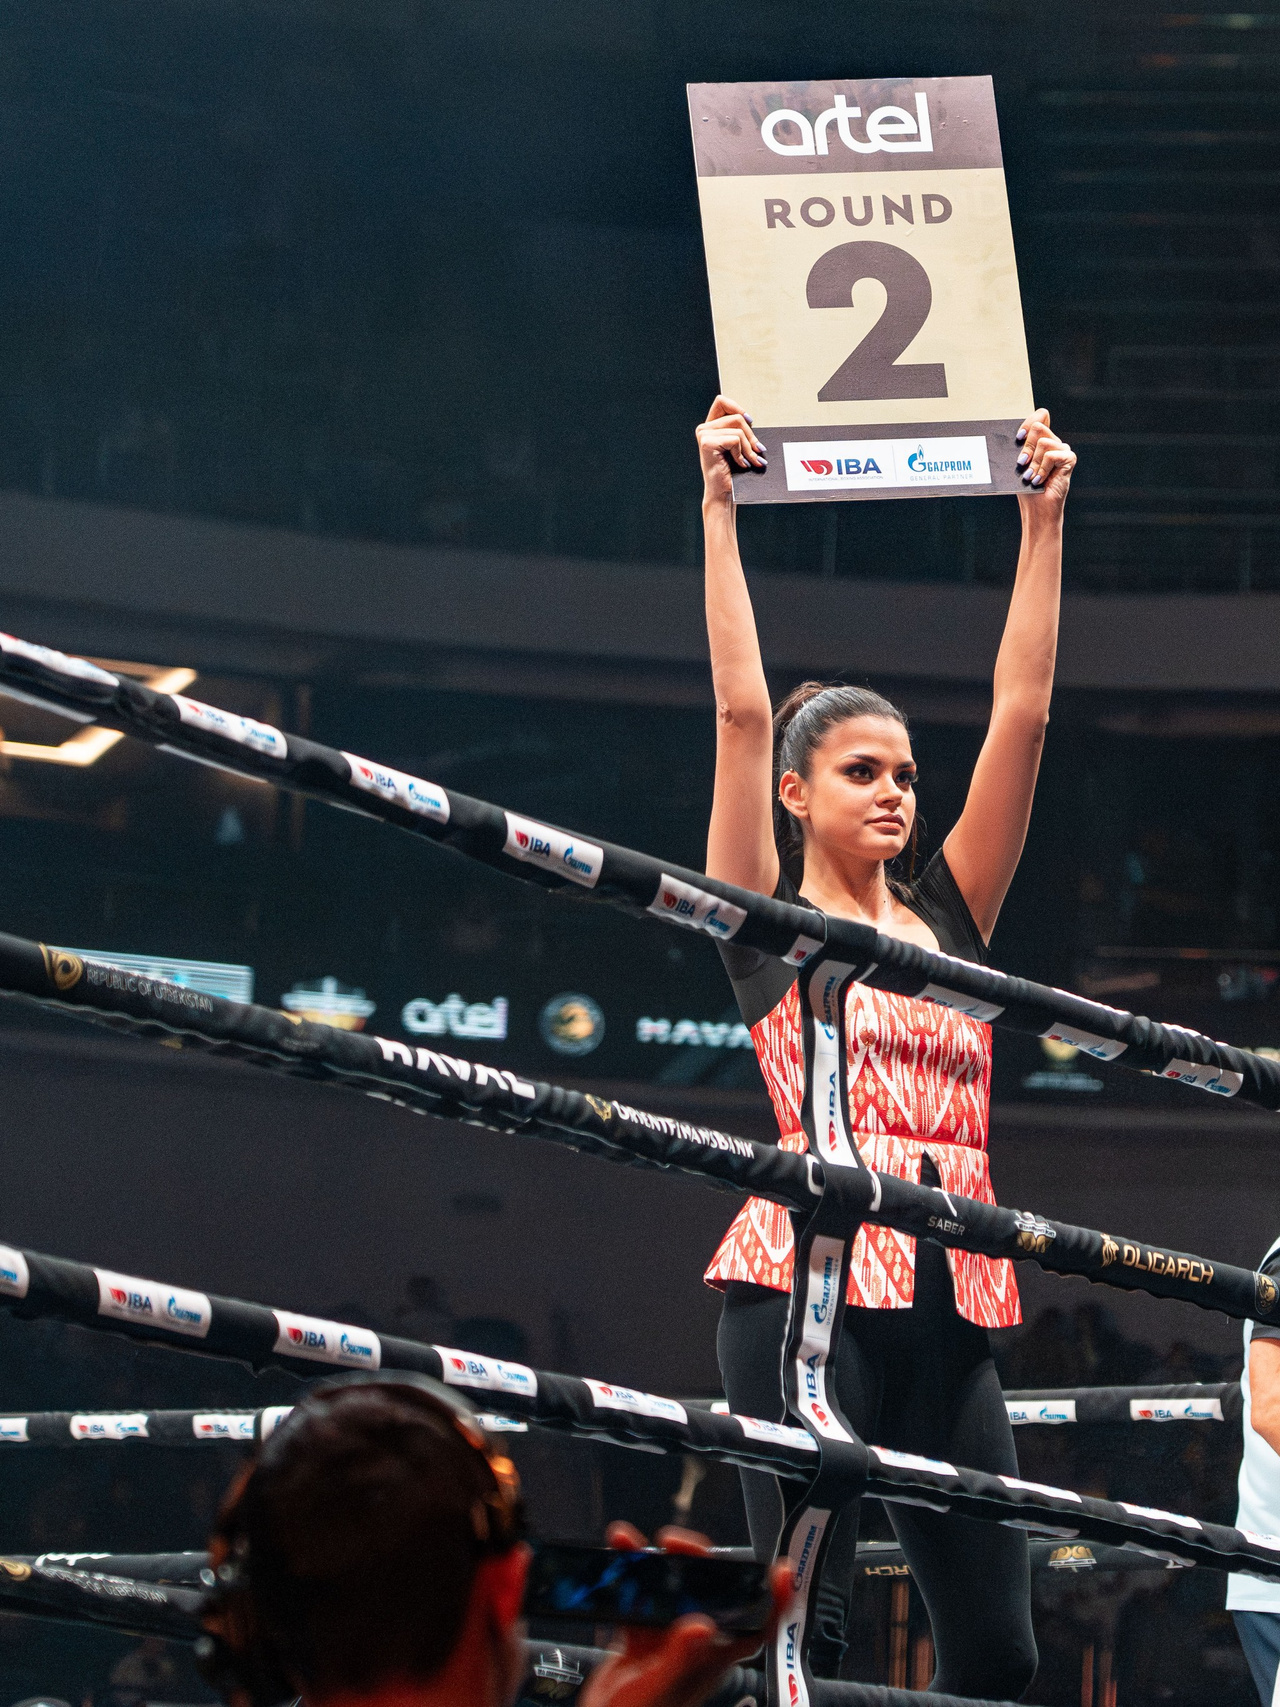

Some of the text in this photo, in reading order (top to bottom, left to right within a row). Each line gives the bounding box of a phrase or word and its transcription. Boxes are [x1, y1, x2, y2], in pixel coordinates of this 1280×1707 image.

[760, 92, 934, 156] artel
[764, 194, 953, 228] ROUND
[805, 240, 949, 402] 2
[836, 457, 882, 475] IBA
[927, 460, 972, 472] GAZPROM
[529, 836, 551, 857] IBA
[675, 899, 696, 918] IBA
[402, 993, 509, 1039] artel
[636, 1017, 755, 1049] HAVA
[928, 1215, 966, 1237] SABER
[1122, 1244, 1215, 1285] OLIGARCH
[128, 1291, 153, 1312] IBA
[304, 1331, 327, 1349] IBA
[466, 1360, 489, 1377] IBA
[807, 1353, 821, 1399] IBA
[1009, 1411, 1029, 1421] IBA
[1155, 1409, 1175, 1419] IBA
[786, 1622, 798, 1669] IBA
